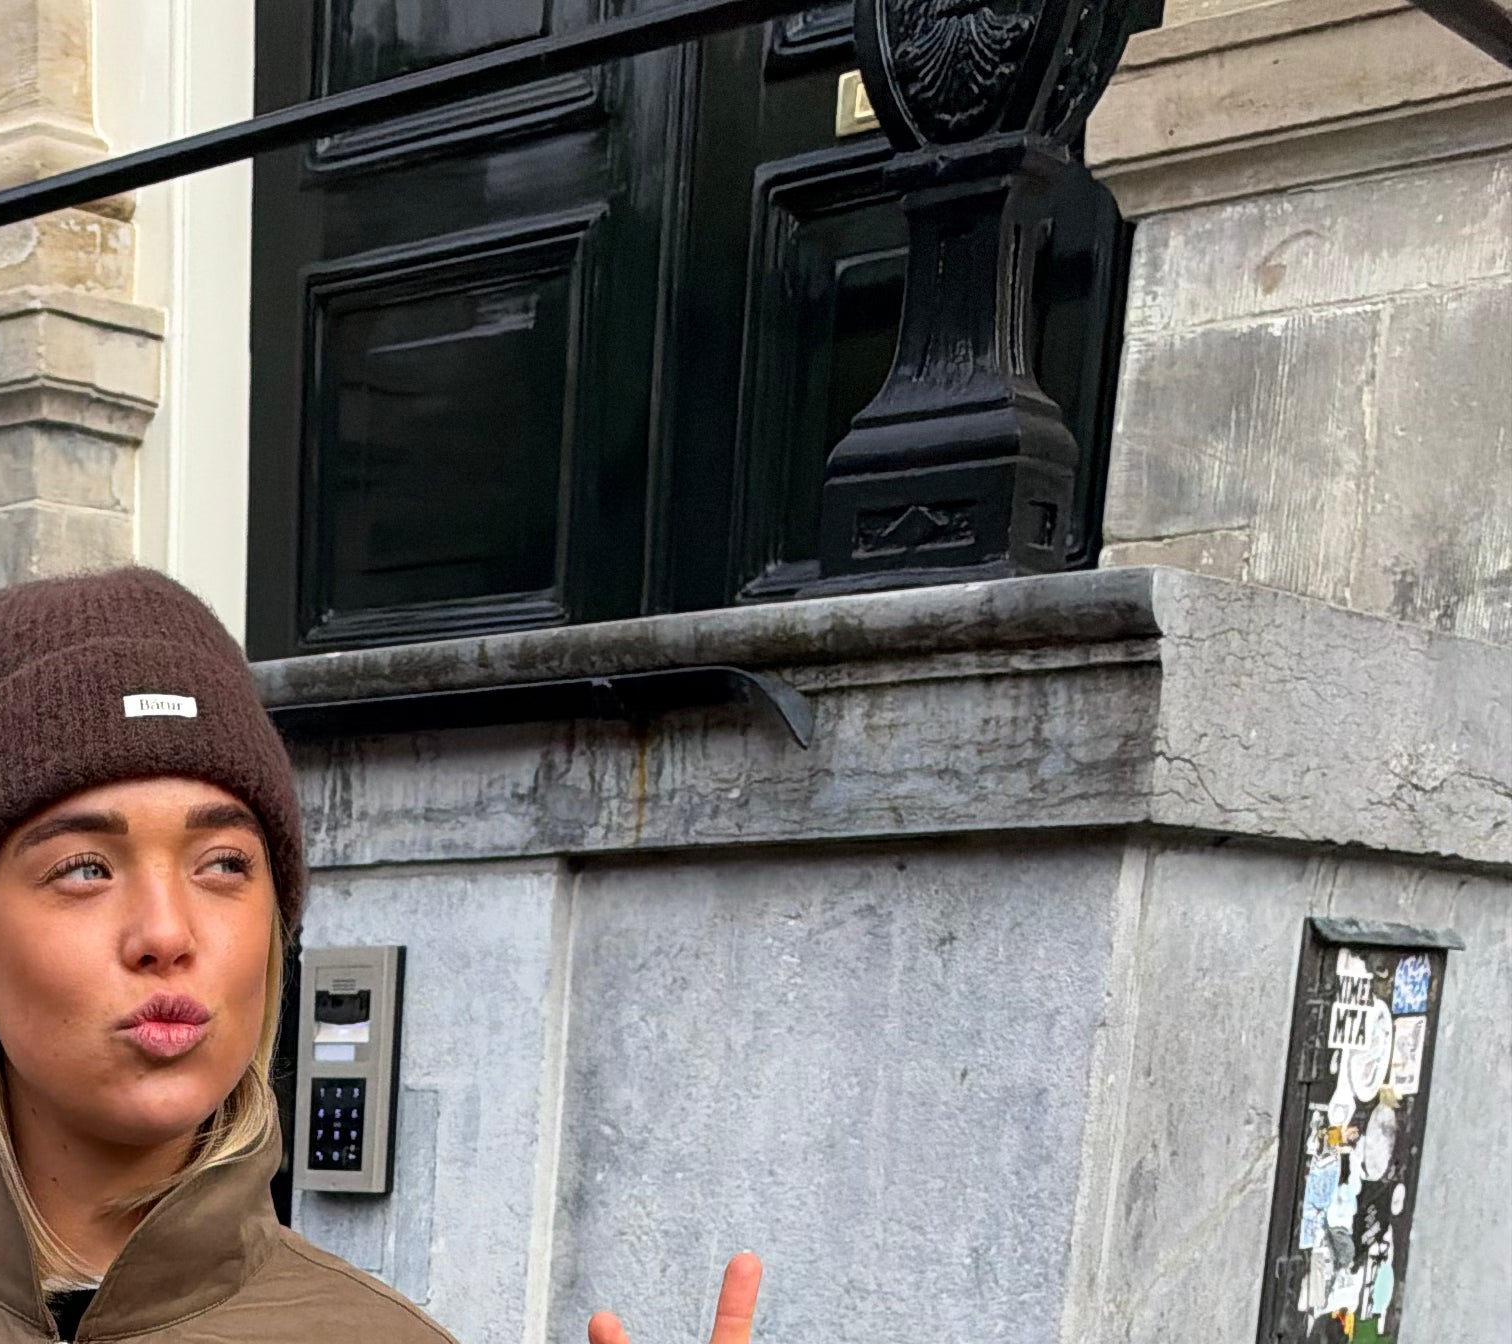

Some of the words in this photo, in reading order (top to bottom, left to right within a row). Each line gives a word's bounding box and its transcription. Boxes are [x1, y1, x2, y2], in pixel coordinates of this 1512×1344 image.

[139, 698, 183, 711] Bátur
[1332, 1007, 1368, 1045] MTA
[335, 1087, 342, 1098] 2
[353, 1087, 360, 1098] 3
[334, 1108, 341, 1119] 5
